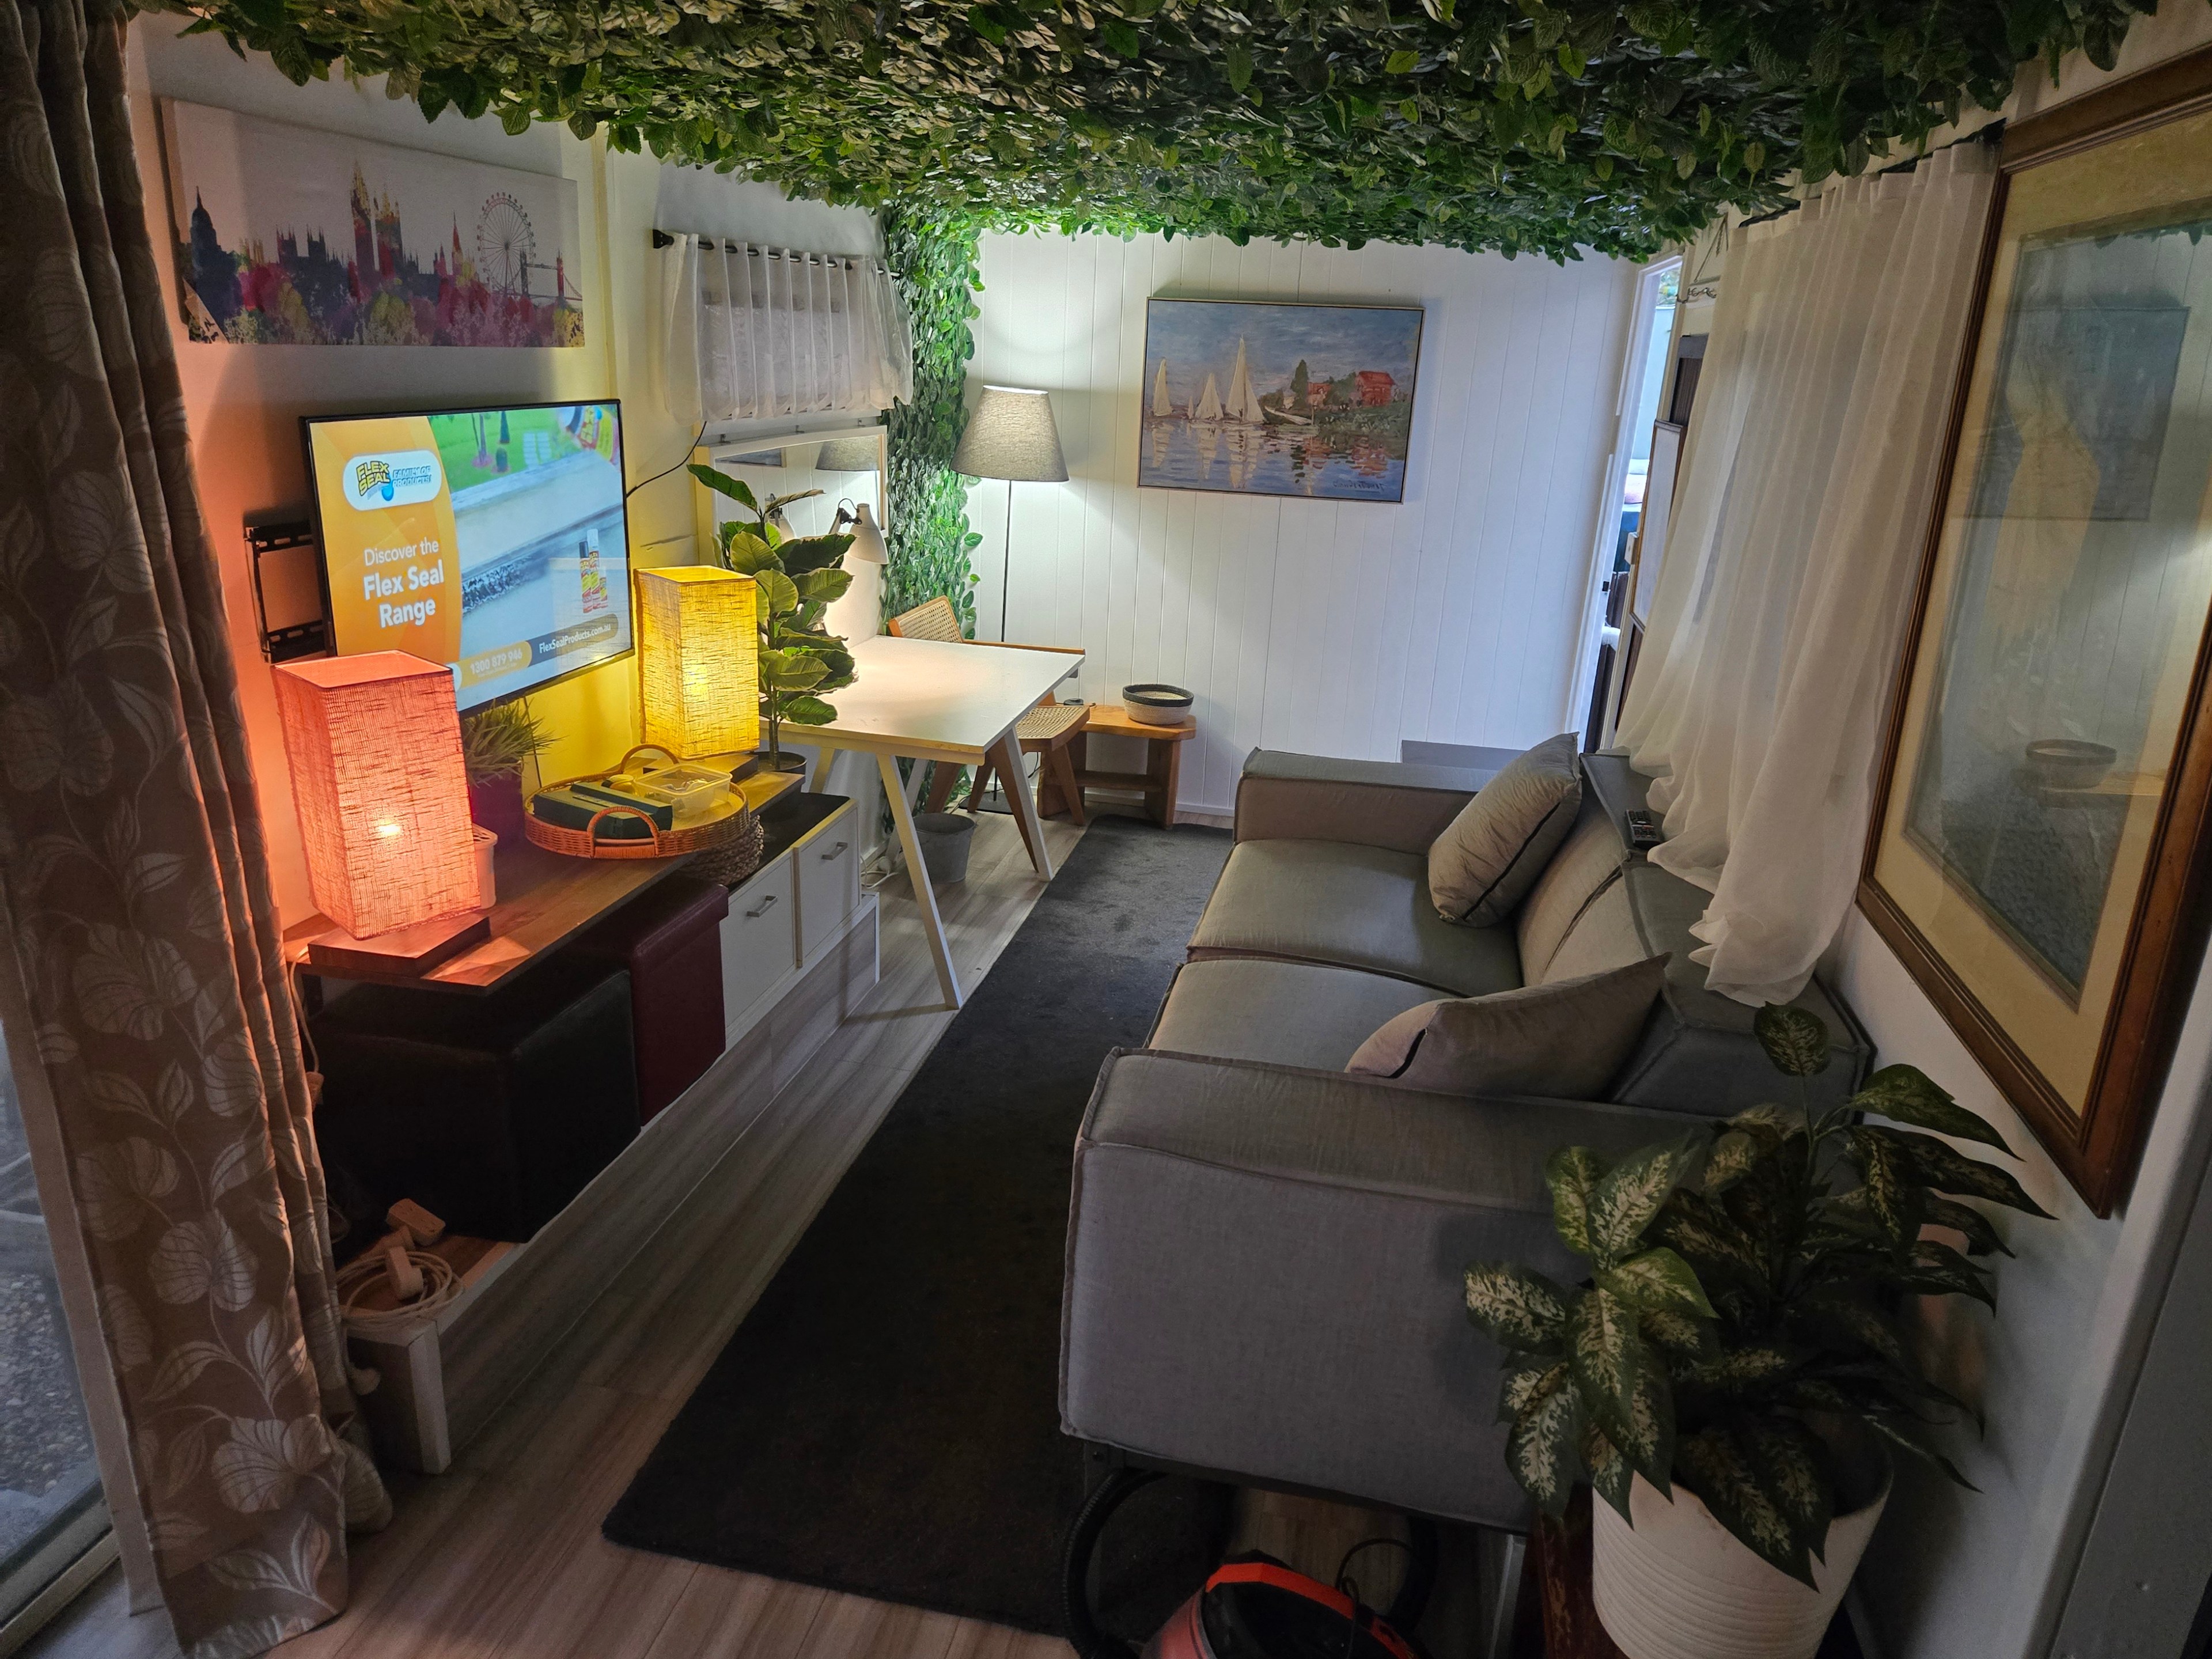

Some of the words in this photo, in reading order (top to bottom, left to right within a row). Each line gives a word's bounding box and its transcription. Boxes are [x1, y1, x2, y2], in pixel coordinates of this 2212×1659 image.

[356, 461, 389, 481] FLEX
[358, 472, 390, 496] SEAL
[392, 467, 420, 478] FAMILY
[421, 465, 431, 475] OF
[364, 544, 417, 566] Discover
[420, 537, 439, 555] the
[363, 572, 404, 600] Flex
[408, 559, 444, 590] Seal
[379, 599, 435, 628] Range
[539, 623, 611, 654] FlexSealProducts.com.au
[470, 659, 490, 674] 1300
[491, 653, 506, 667] 879
